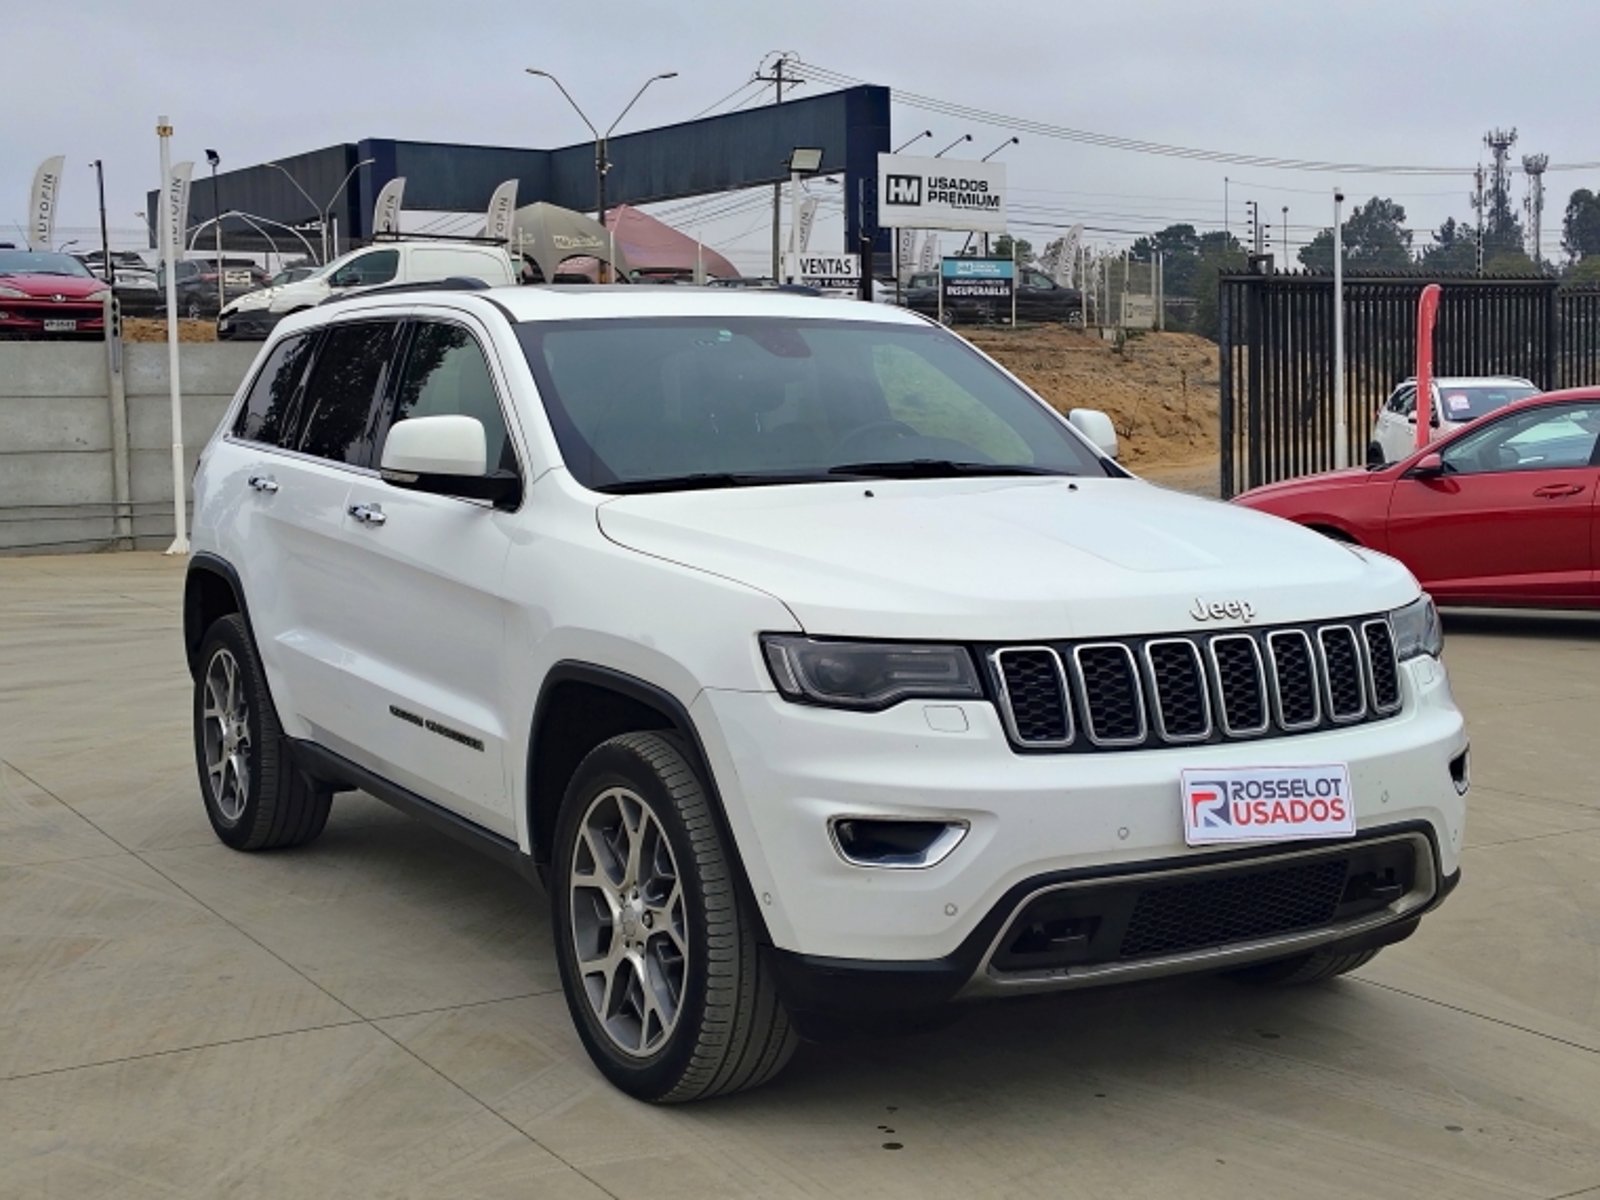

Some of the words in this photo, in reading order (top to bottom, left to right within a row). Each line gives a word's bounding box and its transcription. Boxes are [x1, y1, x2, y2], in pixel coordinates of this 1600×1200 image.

[886, 175, 921, 206] HM
[927, 176, 989, 193] USADOS
[37, 173, 53, 243] AUTOFIN
[927, 190, 1000, 207] PREMIUM
[800, 258, 852, 275] VENTAS
[1190, 596, 1256, 624] Jeep
[1231, 778, 1342, 801] ROSSELOT
[1233, 798, 1345, 826] USADOS
